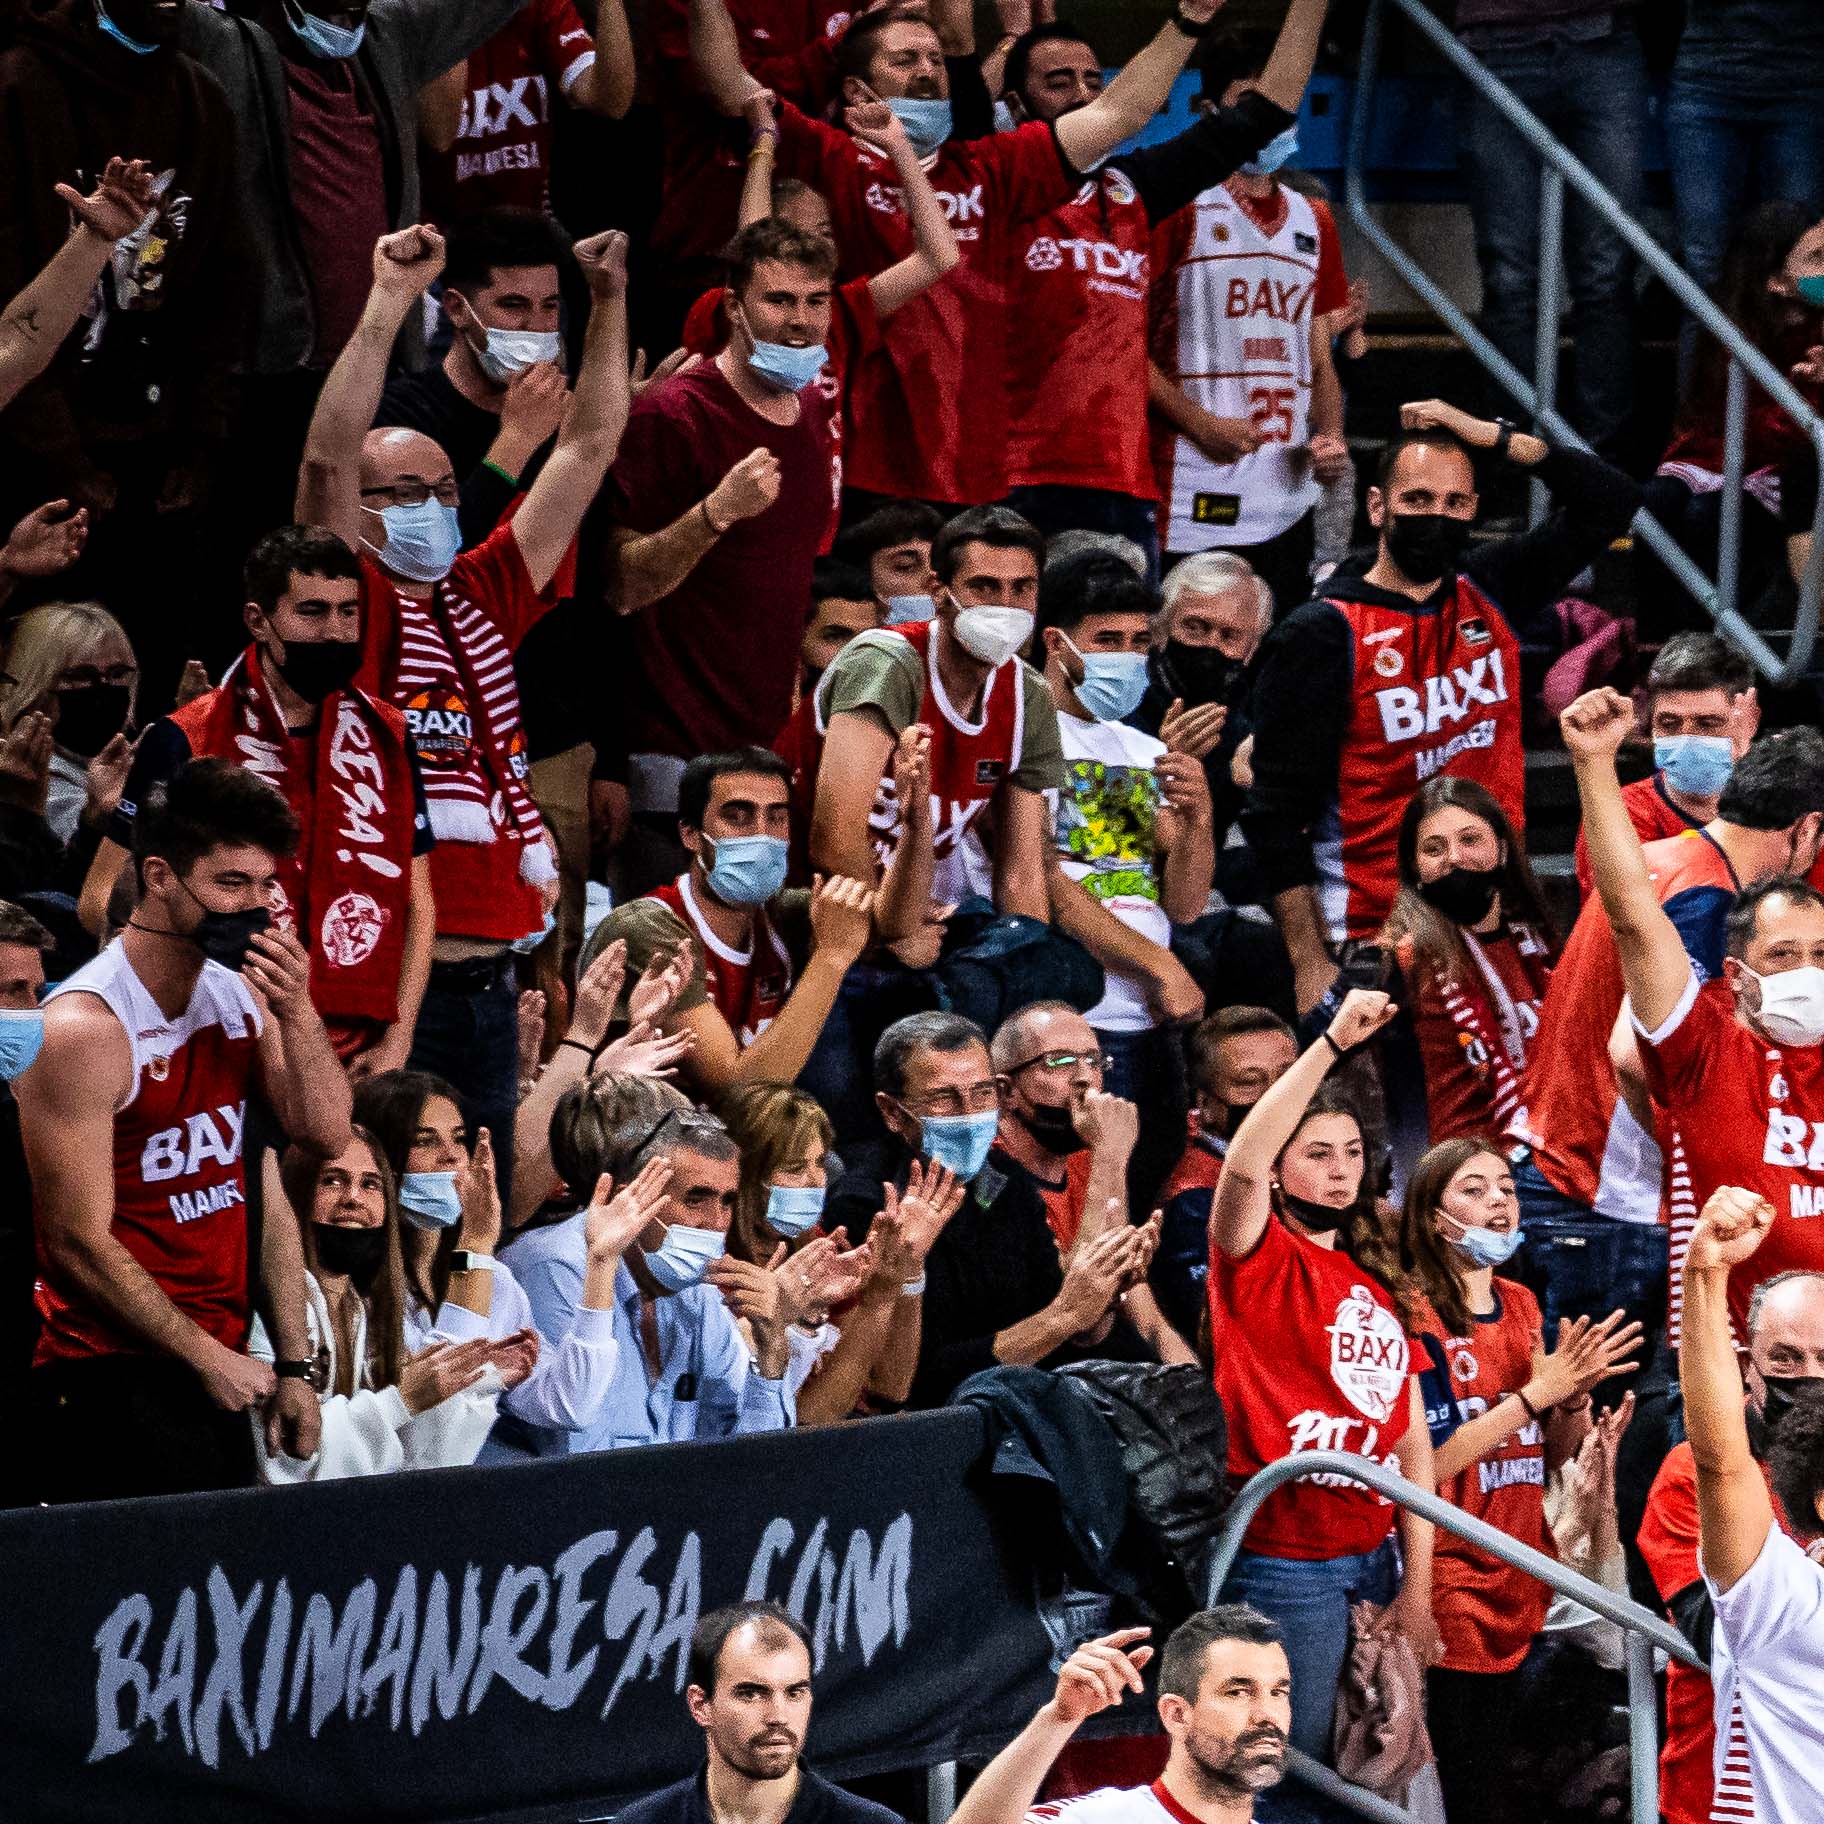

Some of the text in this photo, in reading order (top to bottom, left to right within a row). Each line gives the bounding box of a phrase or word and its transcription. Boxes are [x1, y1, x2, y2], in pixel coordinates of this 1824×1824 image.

[1375, 649, 1508, 744] BAXI
[139, 1100, 247, 1182] BAX
[1337, 1334, 1405, 1370] BAXI
[86, 1512, 912, 1768] BAXIMANRESACOM
